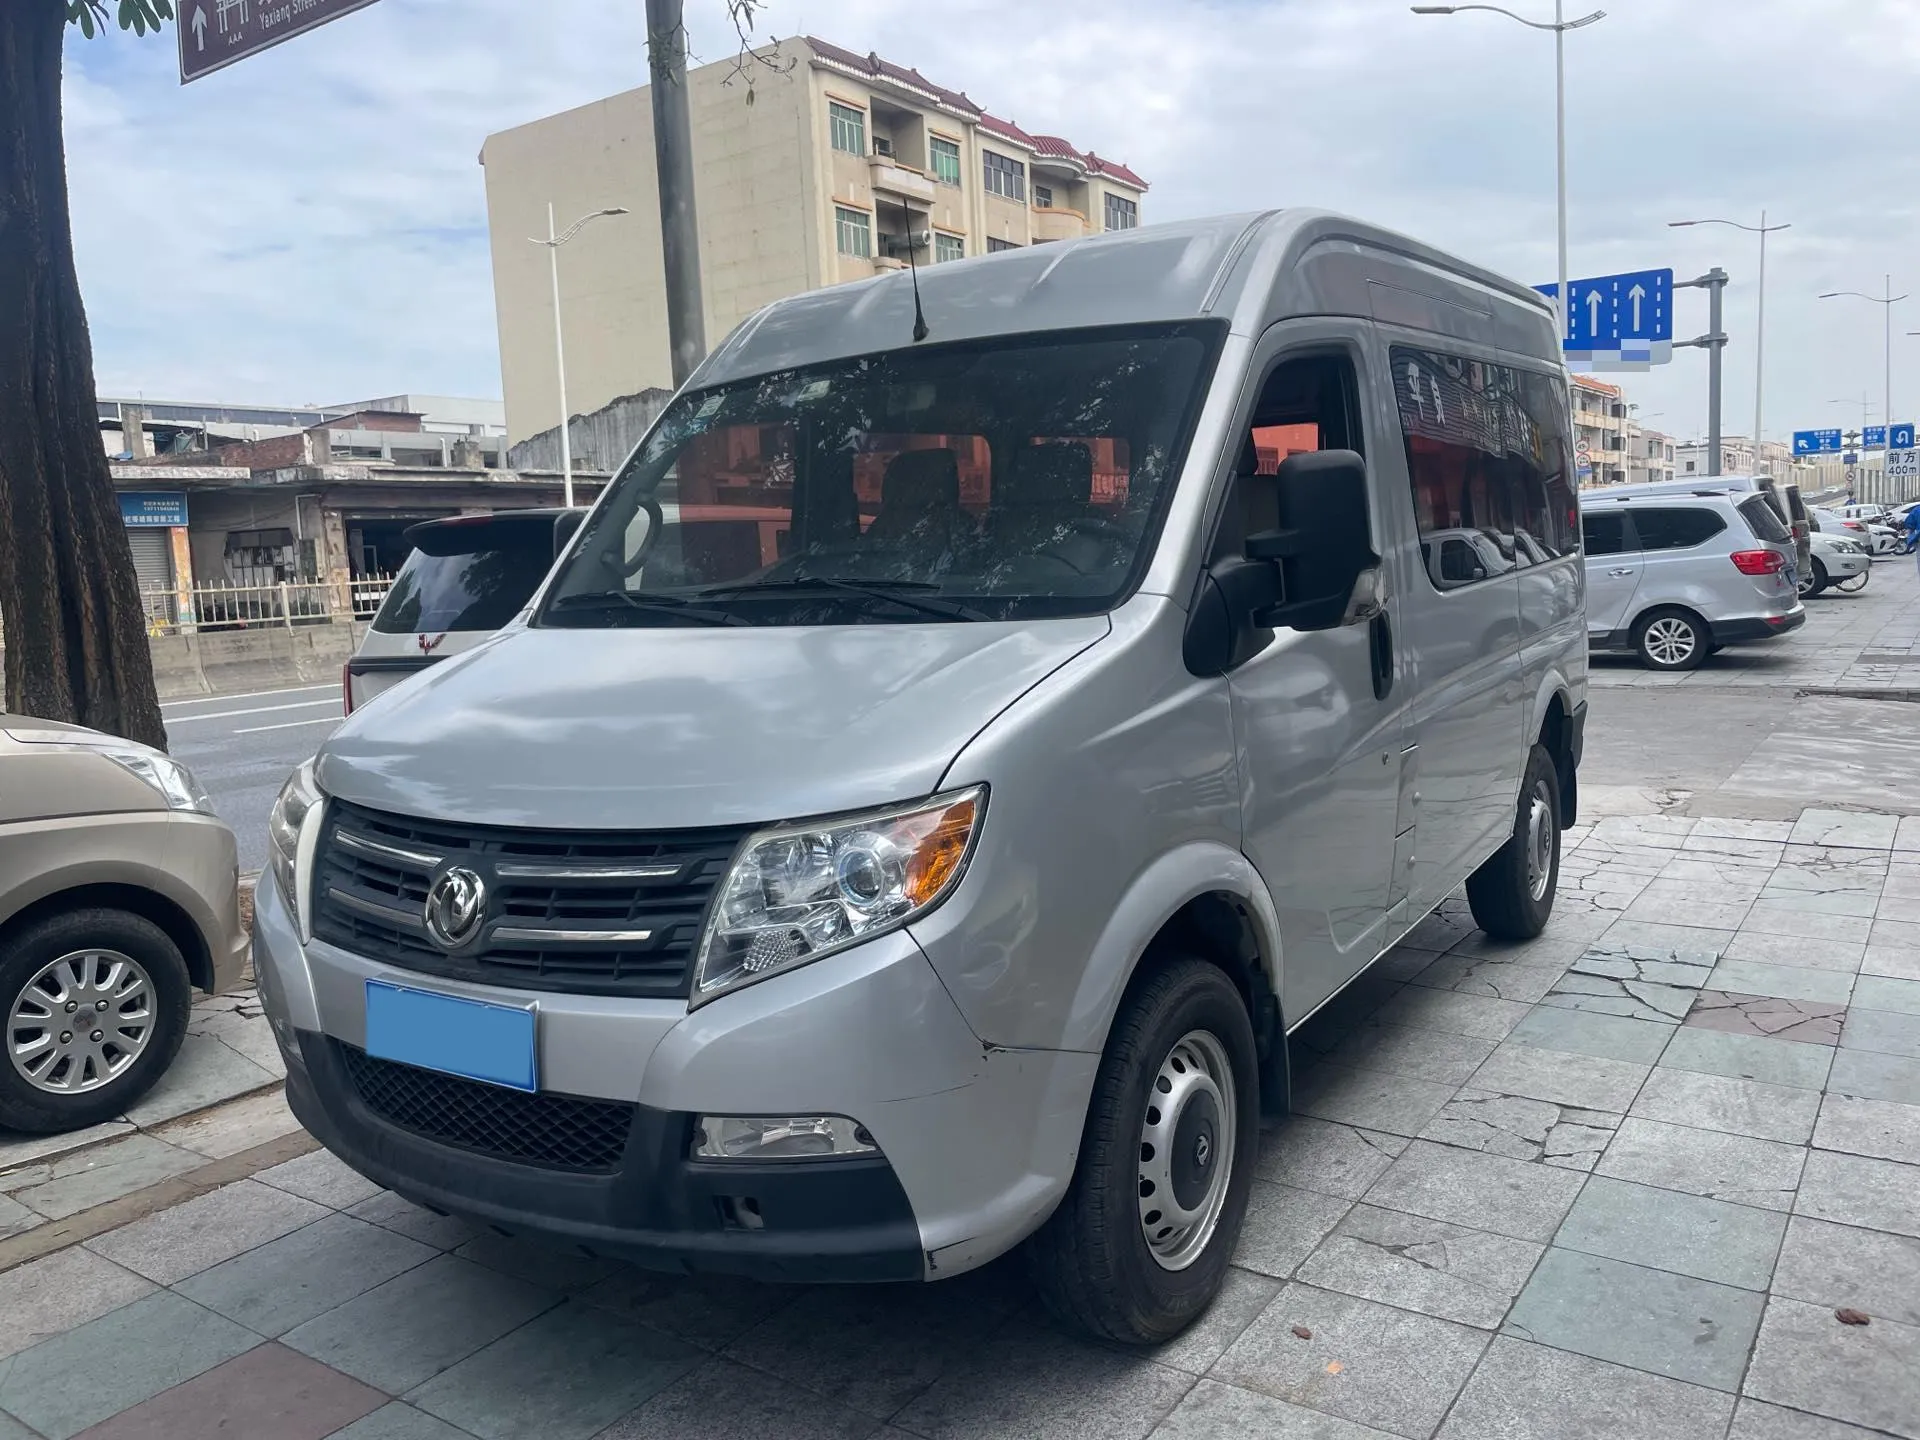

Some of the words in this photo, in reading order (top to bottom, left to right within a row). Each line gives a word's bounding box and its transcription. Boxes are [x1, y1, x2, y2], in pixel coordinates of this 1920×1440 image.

[259, 4, 291, 30] Yaxiang
[228, 31, 244, 46] AAA
[1888, 450, 1917, 464] 前方
[1888, 465, 1917, 475] 400m
